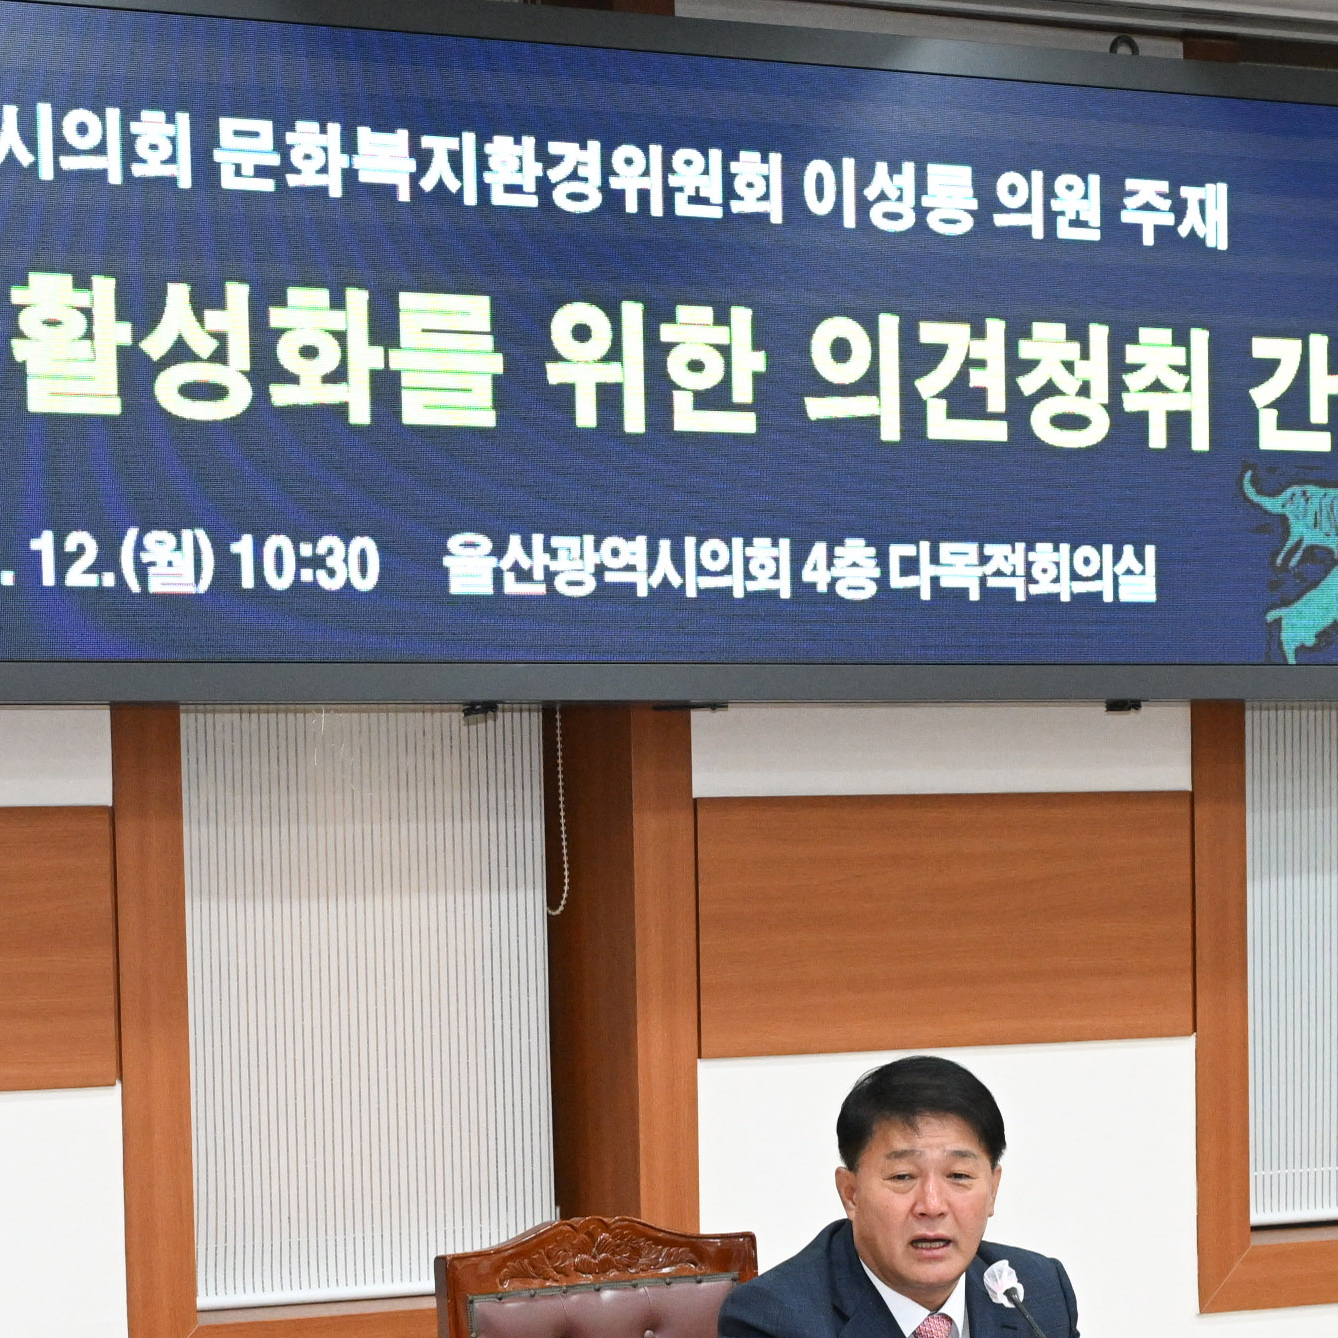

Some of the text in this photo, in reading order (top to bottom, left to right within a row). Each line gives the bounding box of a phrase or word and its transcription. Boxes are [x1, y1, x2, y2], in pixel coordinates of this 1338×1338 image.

[213, 116, 784, 225] 문화복지환경위원회
[803, 156, 979, 237] 이성룡
[993, 169, 1102, 242] 의원
[1120, 178, 1229, 252] 주재
[10, 271, 505, 428] 활성화를
[545, 300, 767, 434] 위한
[804, 312, 1211, 452] 의견청취
[30, 526, 216, 595] 12.(월)
[230, 533, 380, 592] 10:30
[442, 532, 792, 600] 울산광역시의회
[801, 537, 881, 602] 4층
[889, 539, 1158, 604] 다목적회의실
